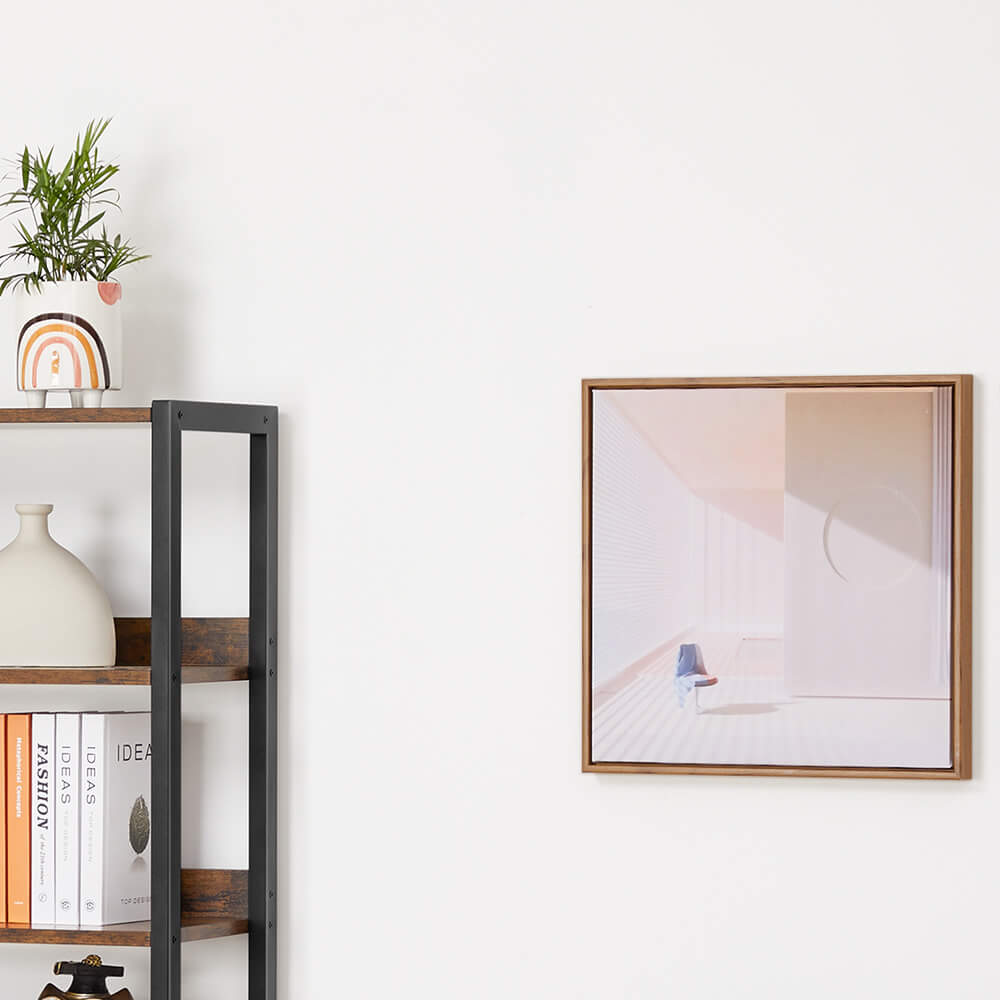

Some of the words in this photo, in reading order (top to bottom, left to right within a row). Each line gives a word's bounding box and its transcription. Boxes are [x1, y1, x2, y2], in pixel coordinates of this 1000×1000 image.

[37, 743, 49, 829] FASHION
[61, 746, 71, 804] IDEAS
[86, 746, 96, 805] IDEAS
